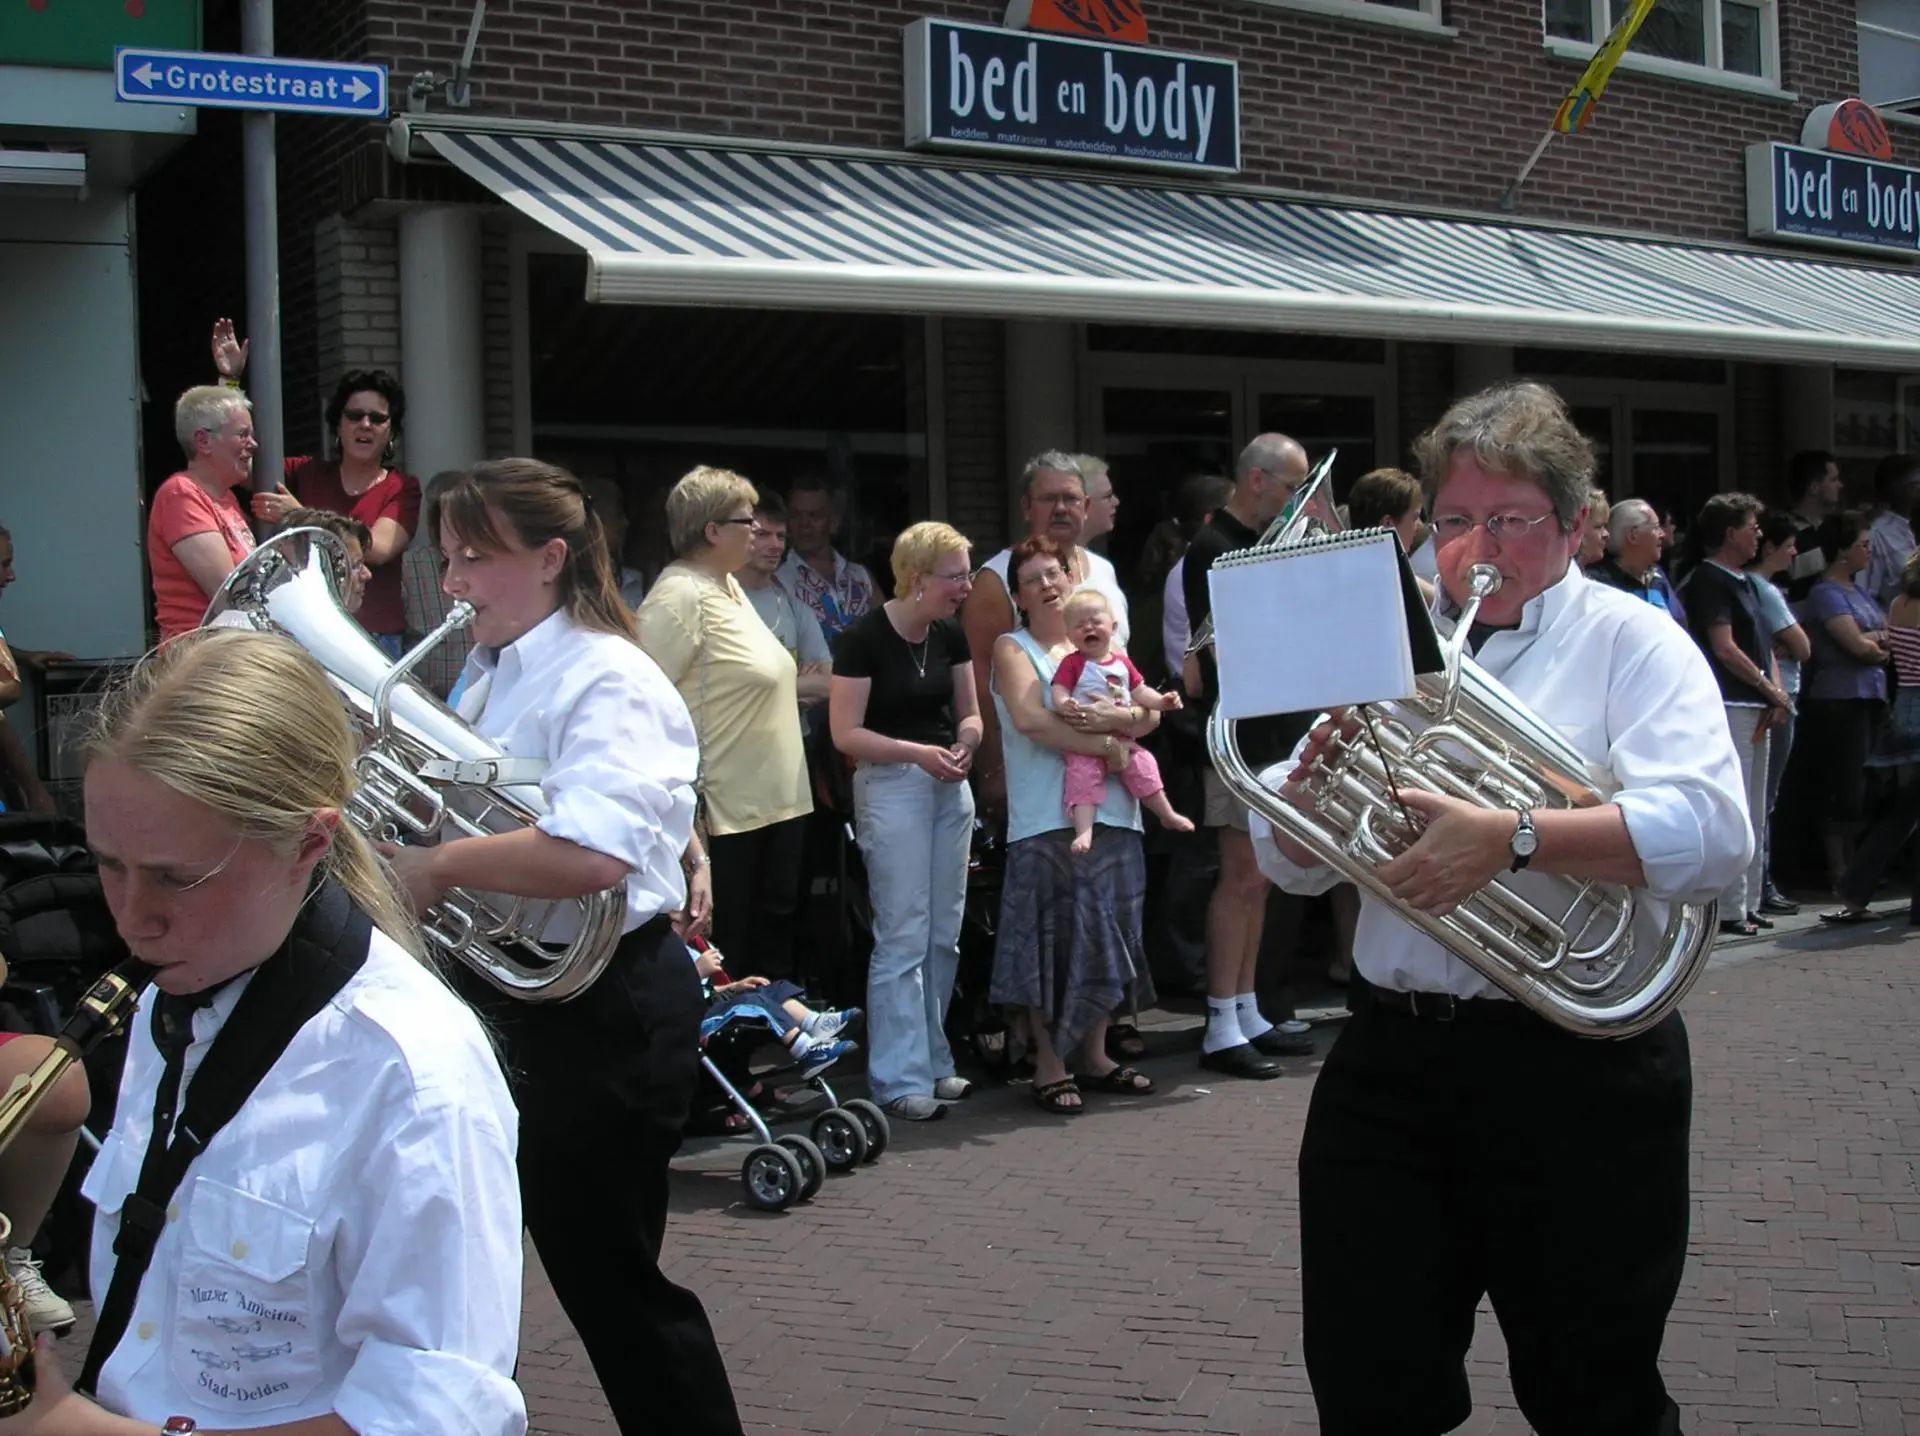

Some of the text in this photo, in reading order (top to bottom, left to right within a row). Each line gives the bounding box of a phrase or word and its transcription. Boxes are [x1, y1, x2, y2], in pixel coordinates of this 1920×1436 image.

[166, 65, 338, 99] Grotestraat
[949, 30, 1215, 162] bed en body
[950, 125, 989, 140] bedden
[997, 131, 1047, 146] matrassen
[1055, 138, 1117, 153] waterbedden
[1784, 151, 1833, 221] bed
[1841, 187, 1858, 213] en
